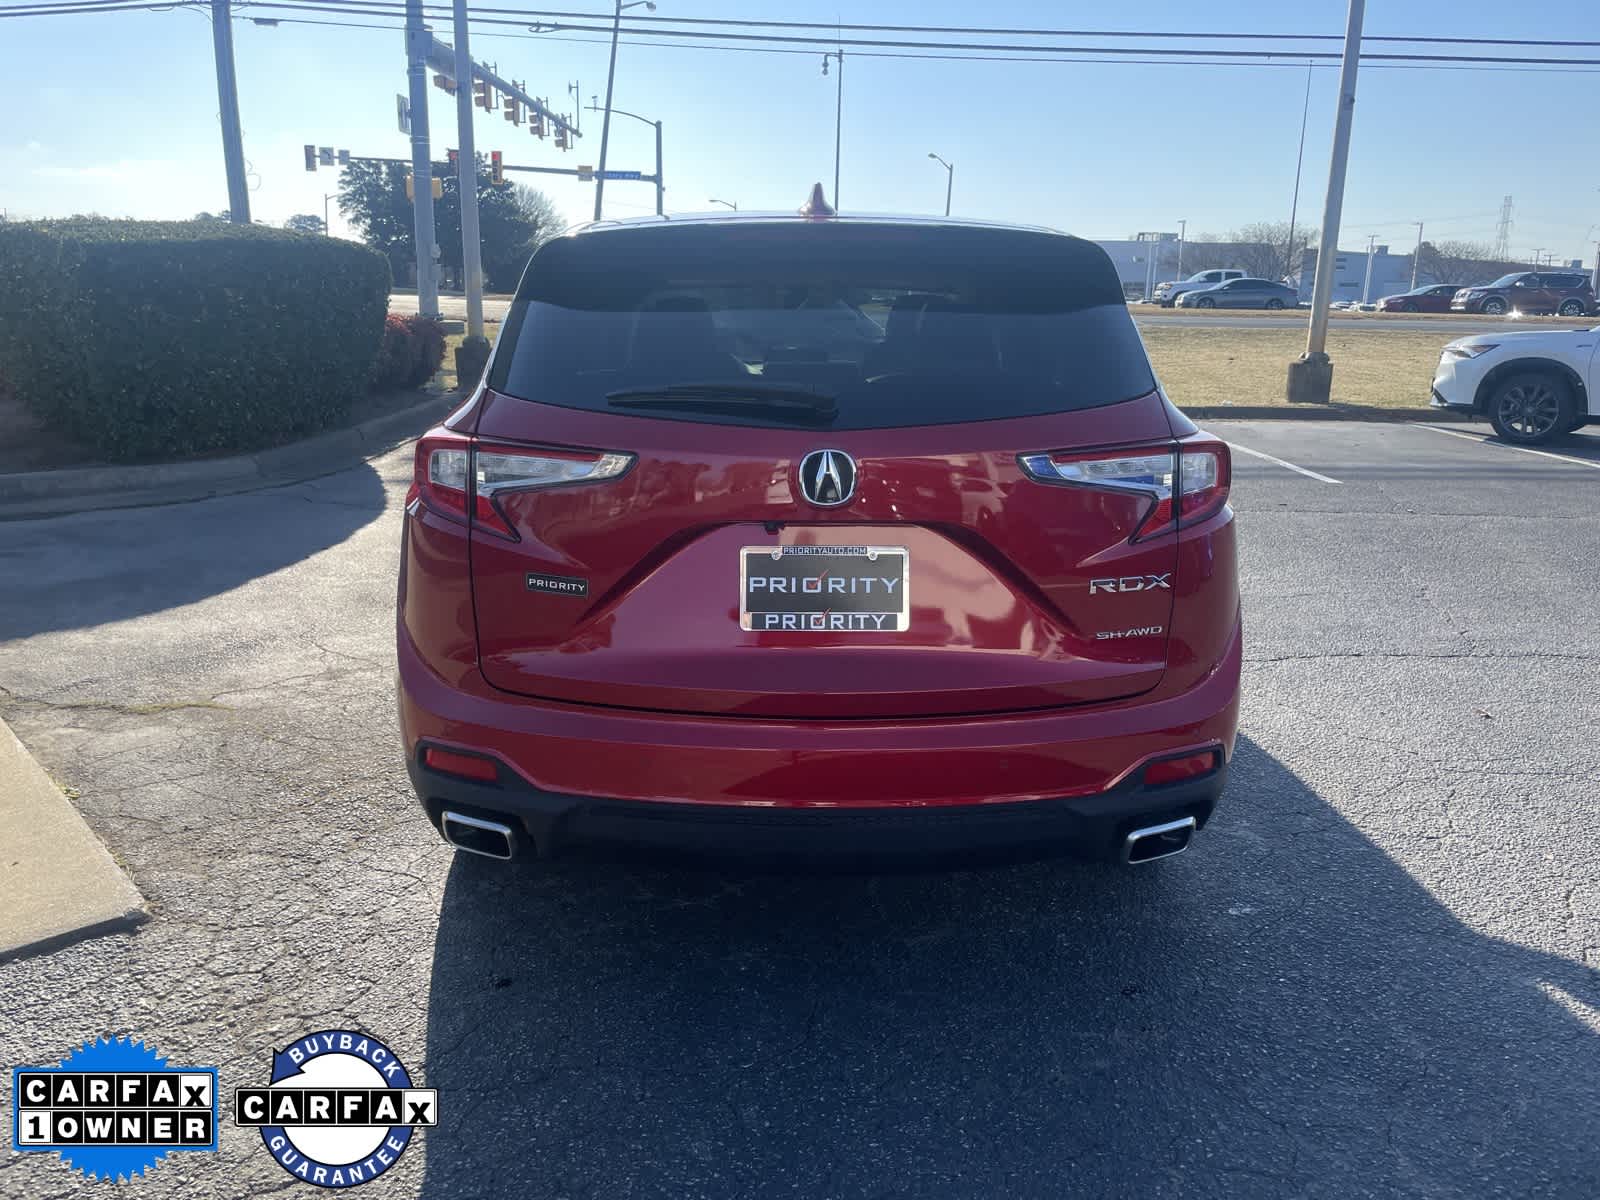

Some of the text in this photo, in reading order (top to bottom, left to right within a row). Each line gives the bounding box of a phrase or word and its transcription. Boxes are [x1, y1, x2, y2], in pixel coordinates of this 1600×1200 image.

[783, 547, 867, 555] PRIORITYAUTO.COM
[528, 578, 585, 592] PRIORITY
[749, 577, 900, 594] PRIORITY
[1089, 572, 1172, 595] RDX
[765, 614, 887, 630] PRIORITY
